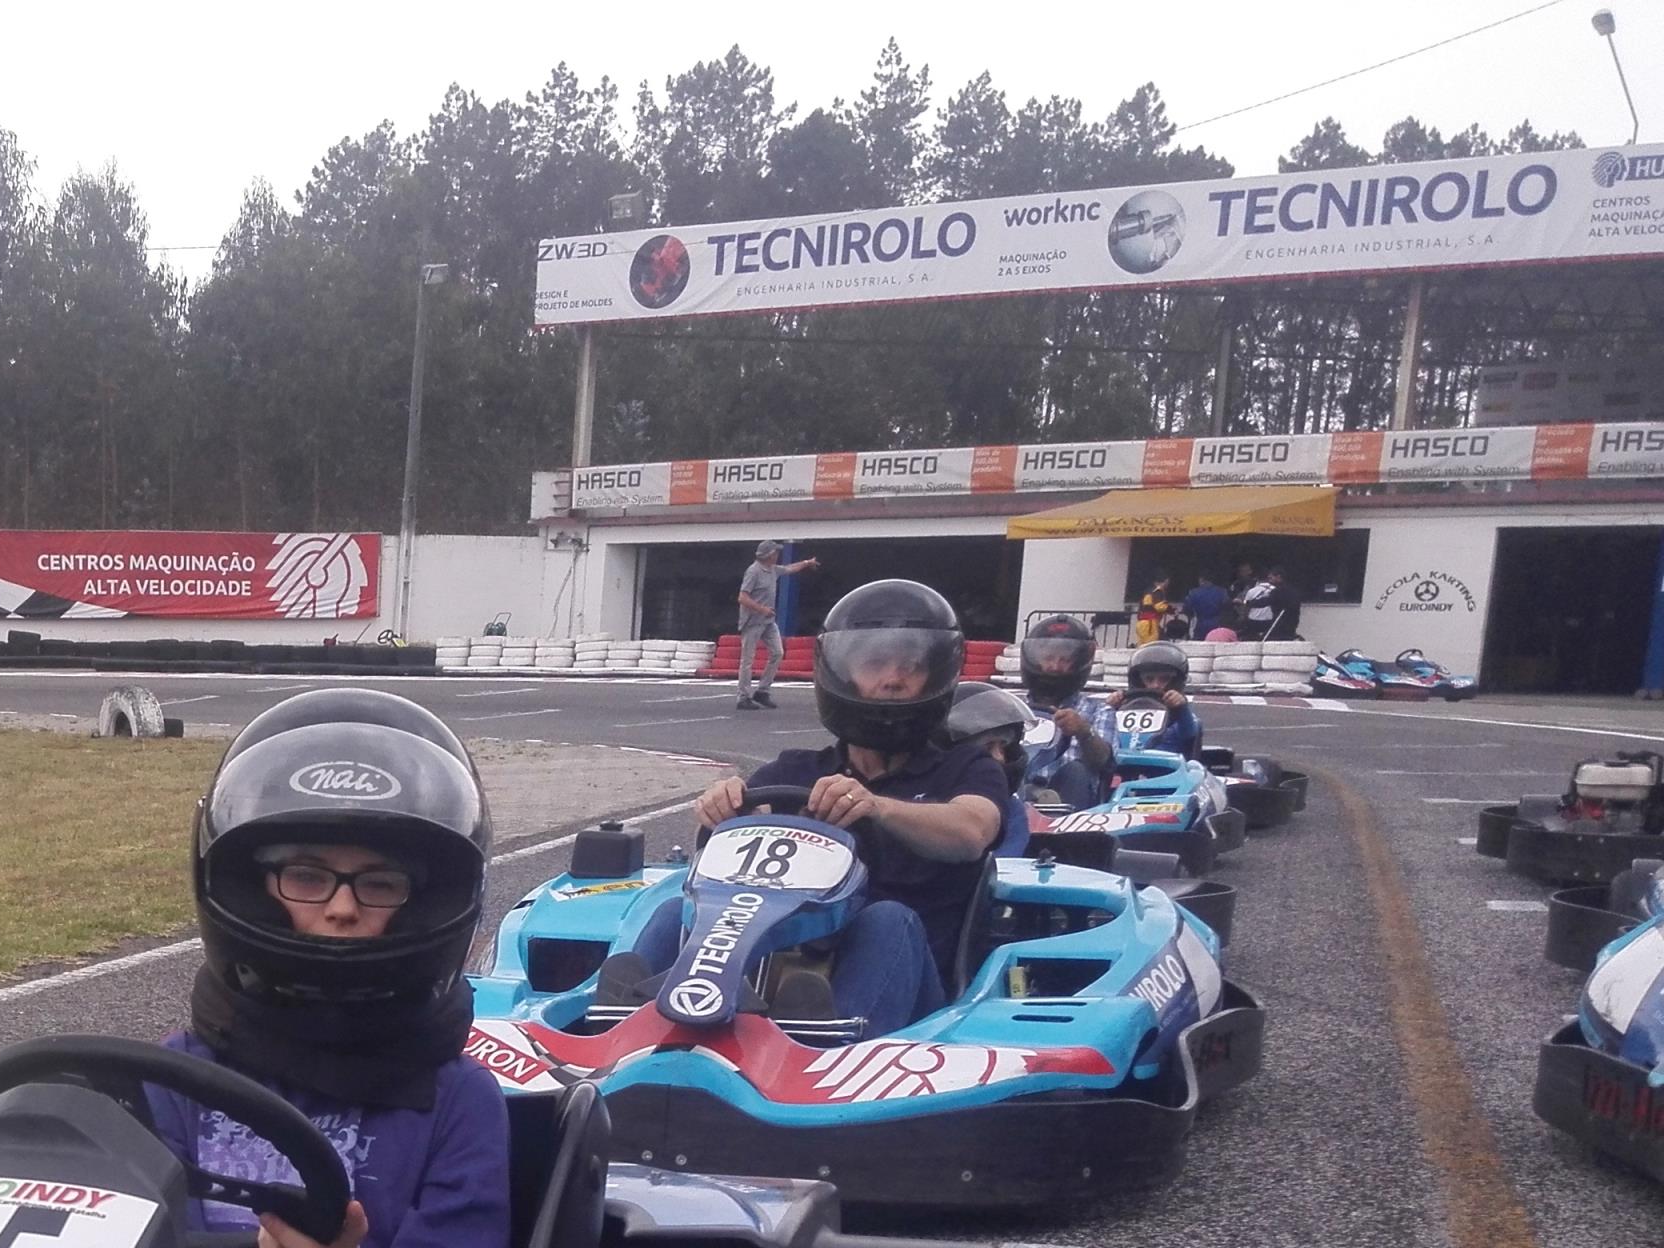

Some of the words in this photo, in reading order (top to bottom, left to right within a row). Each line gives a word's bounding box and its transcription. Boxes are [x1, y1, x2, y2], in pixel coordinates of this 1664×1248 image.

[1208, 164, 1557, 237] TECNIROLO
[1592, 196, 1651, 208] CENTROS
[1003, 198, 1102, 227] worknc
[1588, 227, 1620, 237] ALTA
[707, 212, 977, 276] TECNIROLO
[1245, 243, 1346, 260] ENGENHARIA
[997, 268, 1004, 276] 2
[1005, 267, 1012, 276] A
[1022, 264, 1051, 274] EIXOS
[736, 281, 816, 297] ENGENHARIA
[570, 300, 579, 309] DE
[581, 298, 613, 308] MOLDES
[1199, 442, 1289, 464] HASCO
[1390, 436, 1490, 458] HASCO
[861, 456, 938, 477] HASCO
[1023, 449, 1107, 471] HASCO
[577, 470, 641, 490] HASCO
[713, 463, 783, 483] HASCO
[37, 554, 124, 571] CENTROS
[129, 552, 256, 575] MAQUINAÇÃO
[83, 579, 131, 595] ALTA
[135, 579, 251, 596] VELOCIDADE
[1374, 571, 1421, 611] ESCOLA
[1428, 570, 1477, 612] KARTING
[1399, 602, 1454, 612] EUROINDY
[1123, 711, 1154, 729] 66
[728, 828, 836, 848] EUROINDY
[736, 836, 798, 879] 18
[463, 1031, 538, 1079] URON
